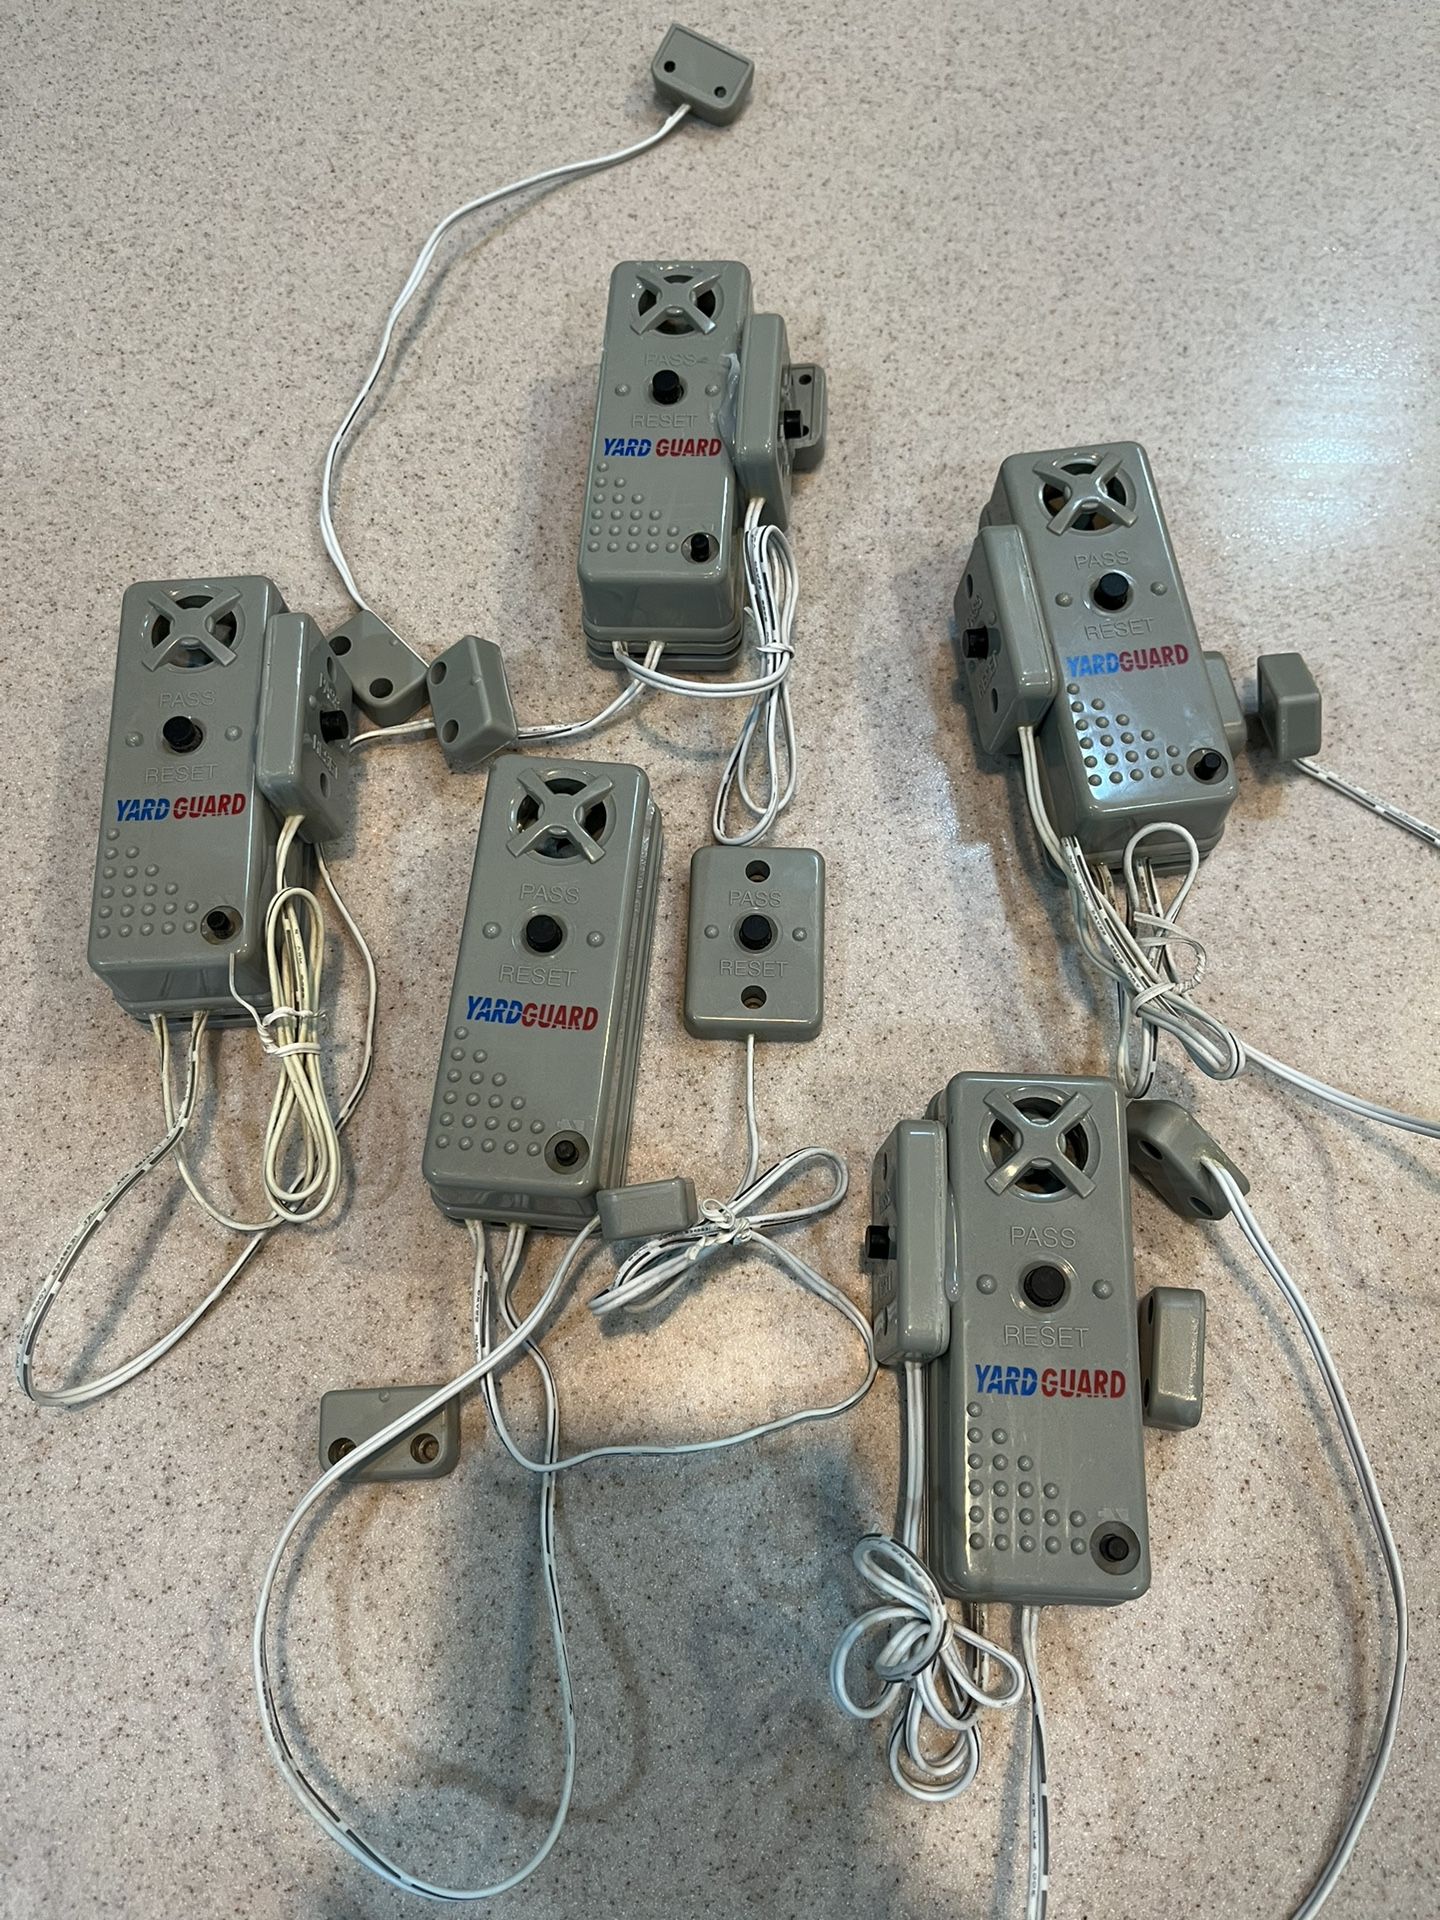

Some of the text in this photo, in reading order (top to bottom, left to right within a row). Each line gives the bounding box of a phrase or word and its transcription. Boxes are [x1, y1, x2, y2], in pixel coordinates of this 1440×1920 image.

[630, 413, 699, 430] RESET
[603, 438, 722, 457] YARD GUARD
[1074, 550, 1131, 570] PASS
[1084, 617, 1155, 640] RESET
[158, 690, 216, 708] PASS
[144, 764, 218, 784] RESET
[116, 793, 246, 822] YARD GUARD
[519, 883, 581, 904] PASS
[728, 889, 783, 907] PASS
[499, 963, 578, 987] RESET
[719, 959, 789, 978] RESET
[1009, 1225, 1077, 1249] PASS
[1003, 1324, 1090, 1349] RESET
[975, 1364, 1127, 1399] YARD GUARD
